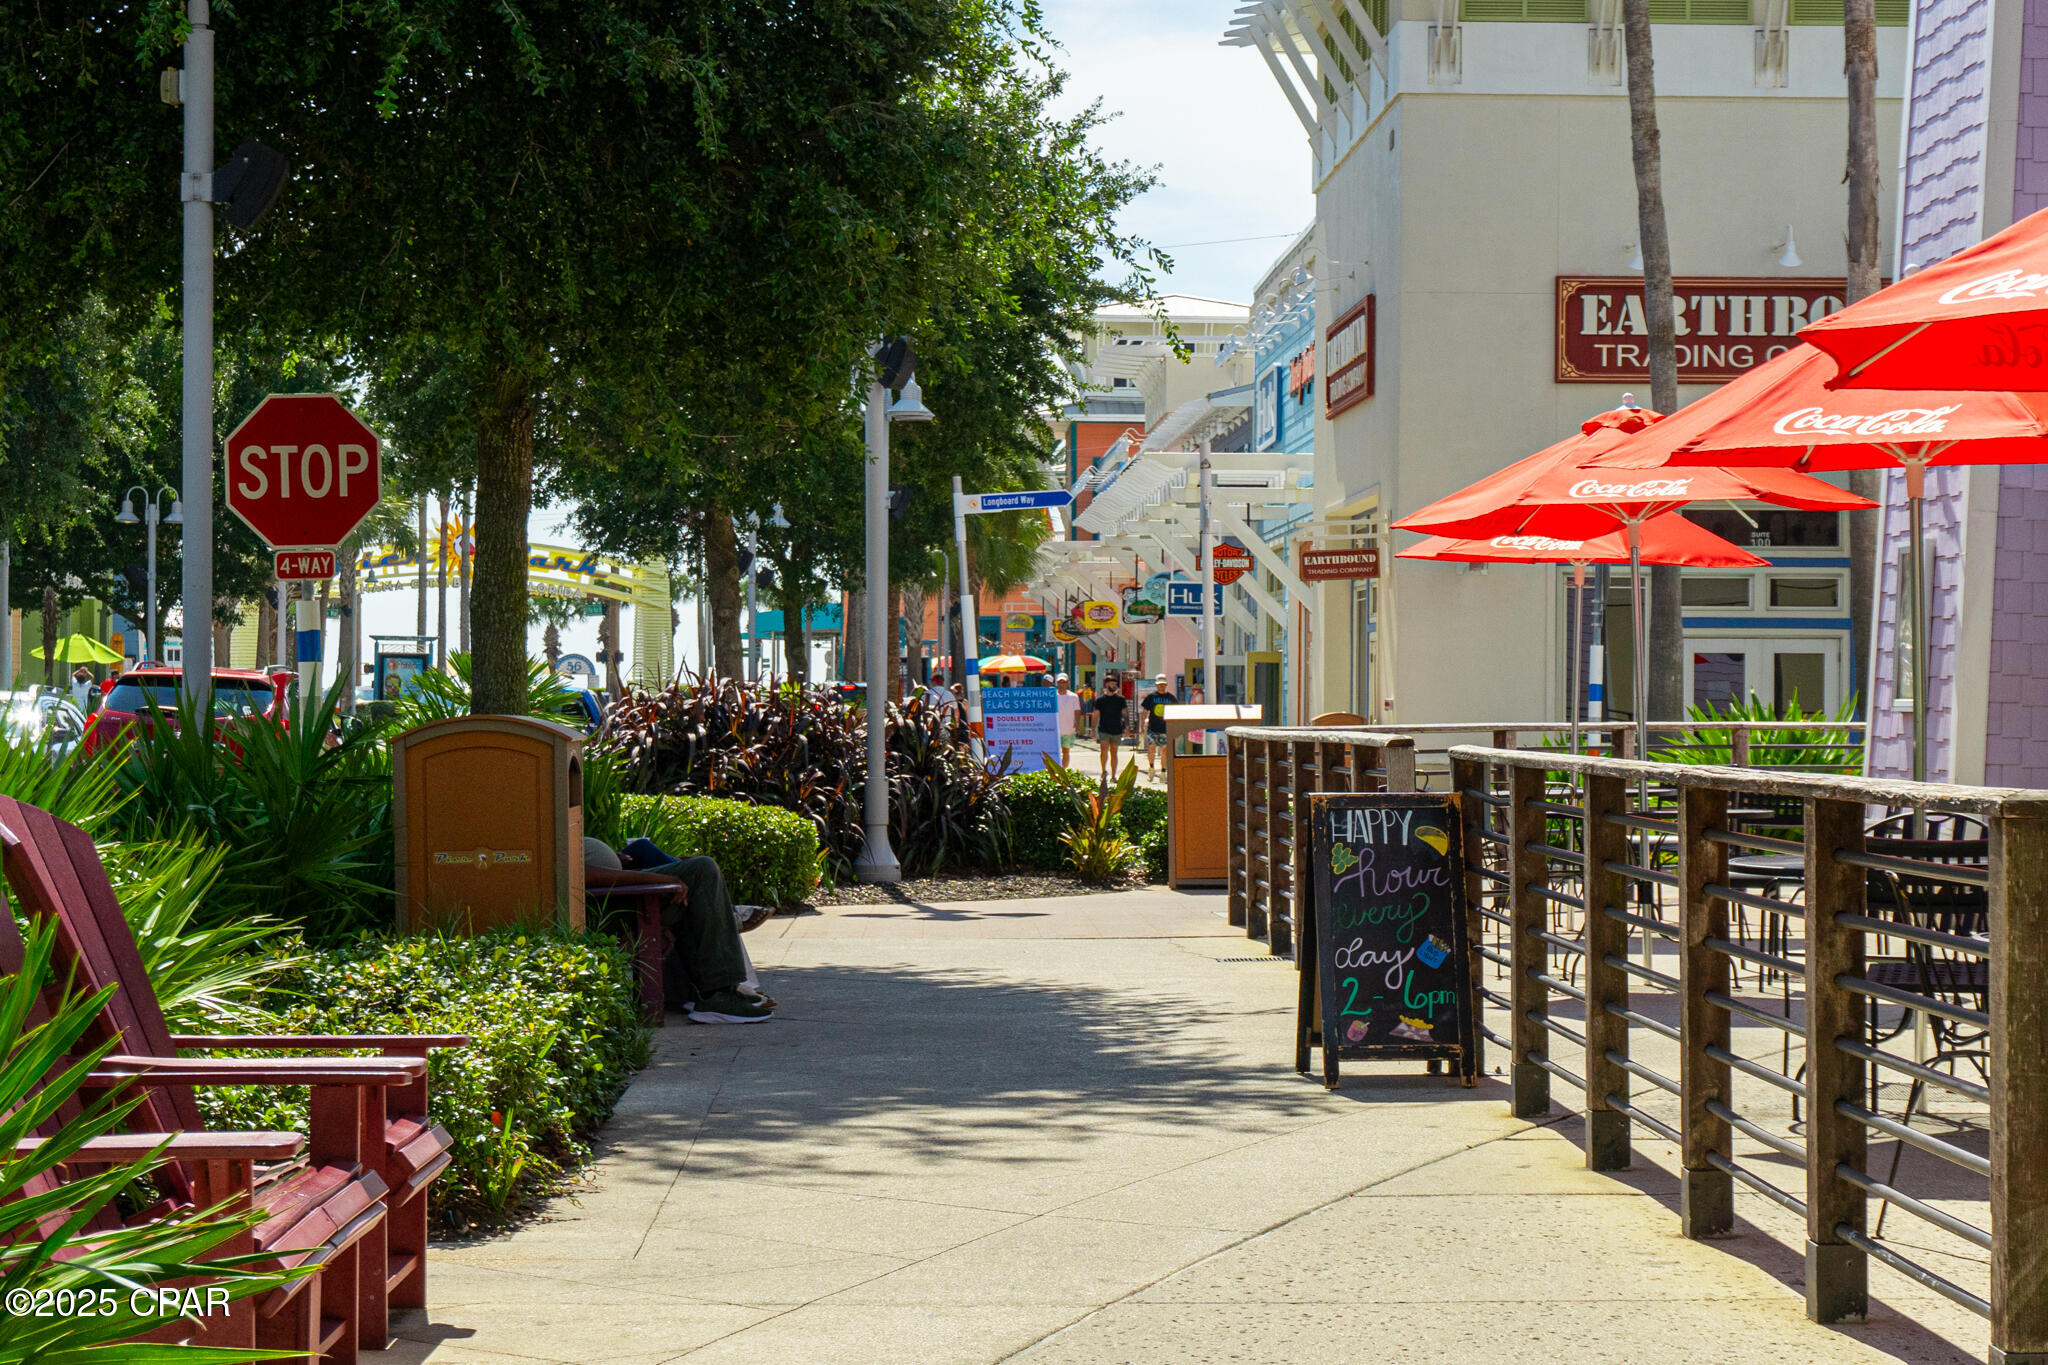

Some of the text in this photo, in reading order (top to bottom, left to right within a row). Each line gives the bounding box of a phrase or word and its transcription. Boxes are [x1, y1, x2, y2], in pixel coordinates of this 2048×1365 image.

[1773, 404, 1963, 435] Coca-Cola
[238, 444, 369, 499] STOP
[1568, 477, 1695, 498] Coca-Cola
[983, 496, 1035, 508] Longboard Way
[1752, 538, 1771, 546] 100
[280, 557, 332, 574] 4-WAY
[527, 544, 608, 578] ark
[1304, 554, 1376, 566] EARTHBOUND
[527, 582, 581, 598] LORIDA
[567, 661, 582, 672] 56
[982, 689, 1055, 699] BEACH WARNING
[986, 699, 1052, 710] FLAG SYSTEM
[1330, 809, 1413, 845] HAPPY
[1334, 848, 1449, 897] hour
[1338, 893, 1430, 943] every
[1335, 937, 1415, 989] day
